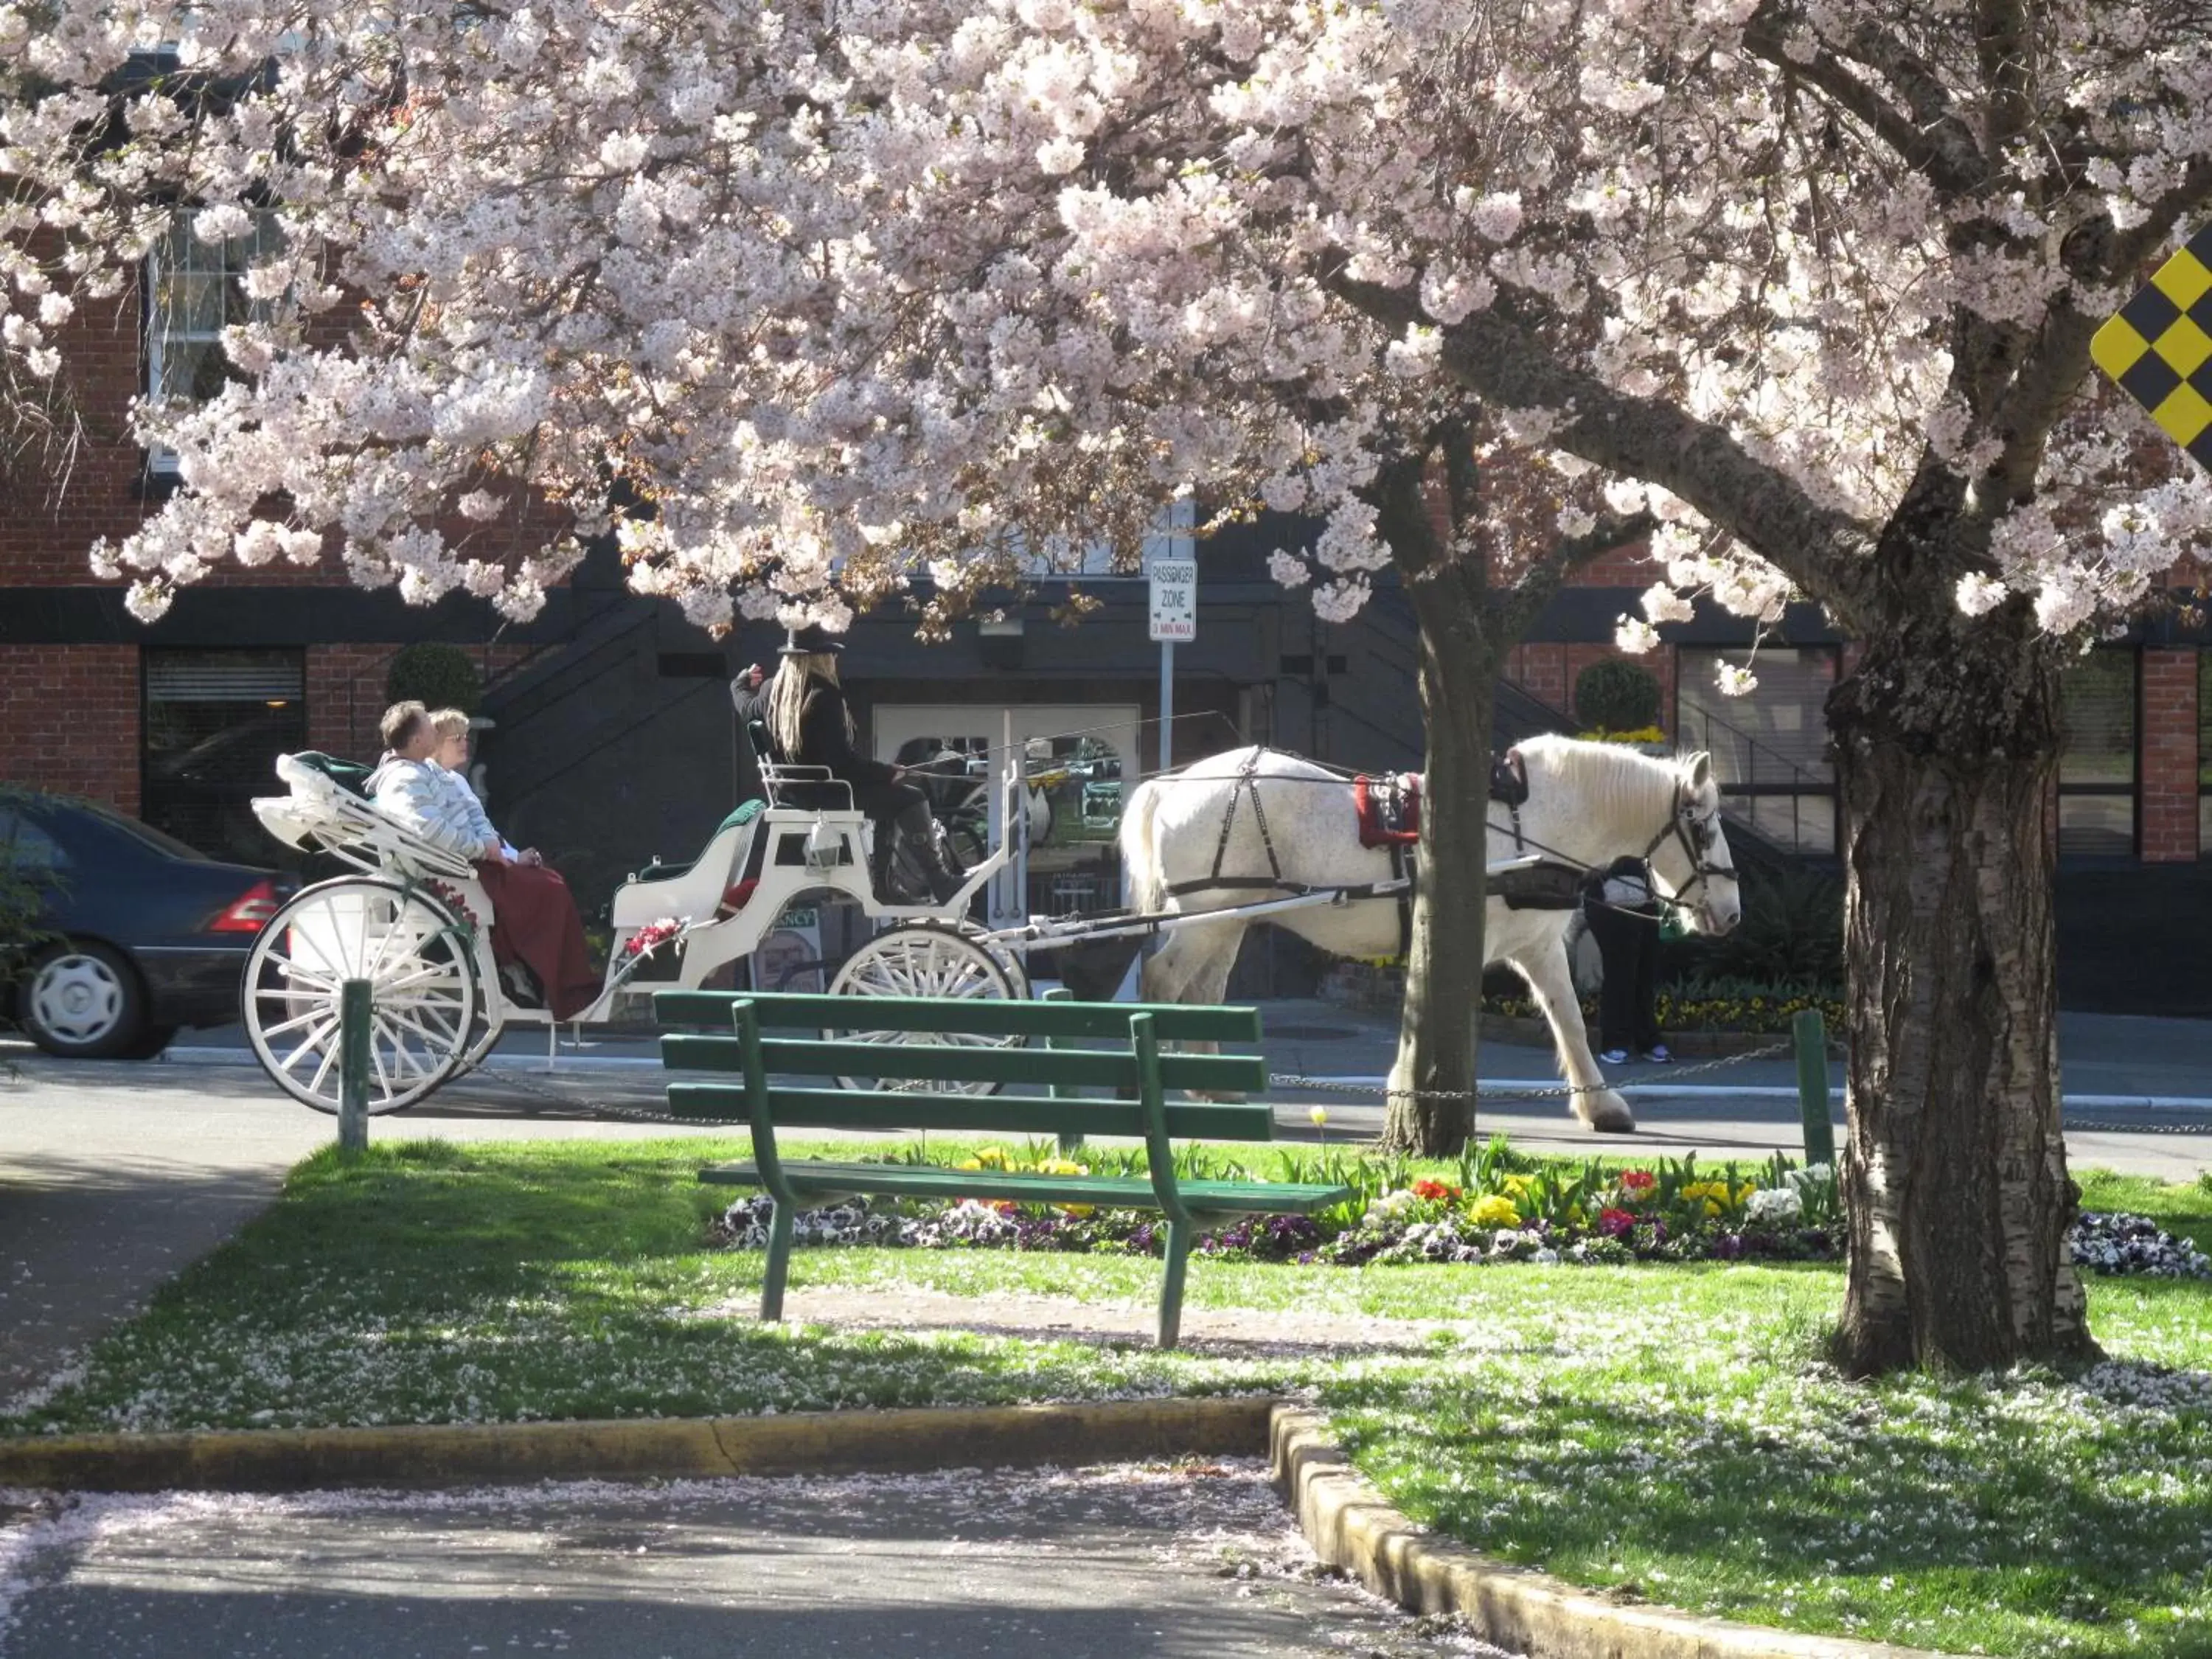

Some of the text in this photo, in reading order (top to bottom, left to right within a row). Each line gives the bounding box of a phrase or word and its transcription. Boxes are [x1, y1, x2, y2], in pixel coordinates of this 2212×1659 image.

[1153, 566, 1193, 584] PASSENGER
[1161, 590, 1185, 608] ZONE
[1160, 623, 1173, 634] MIN
